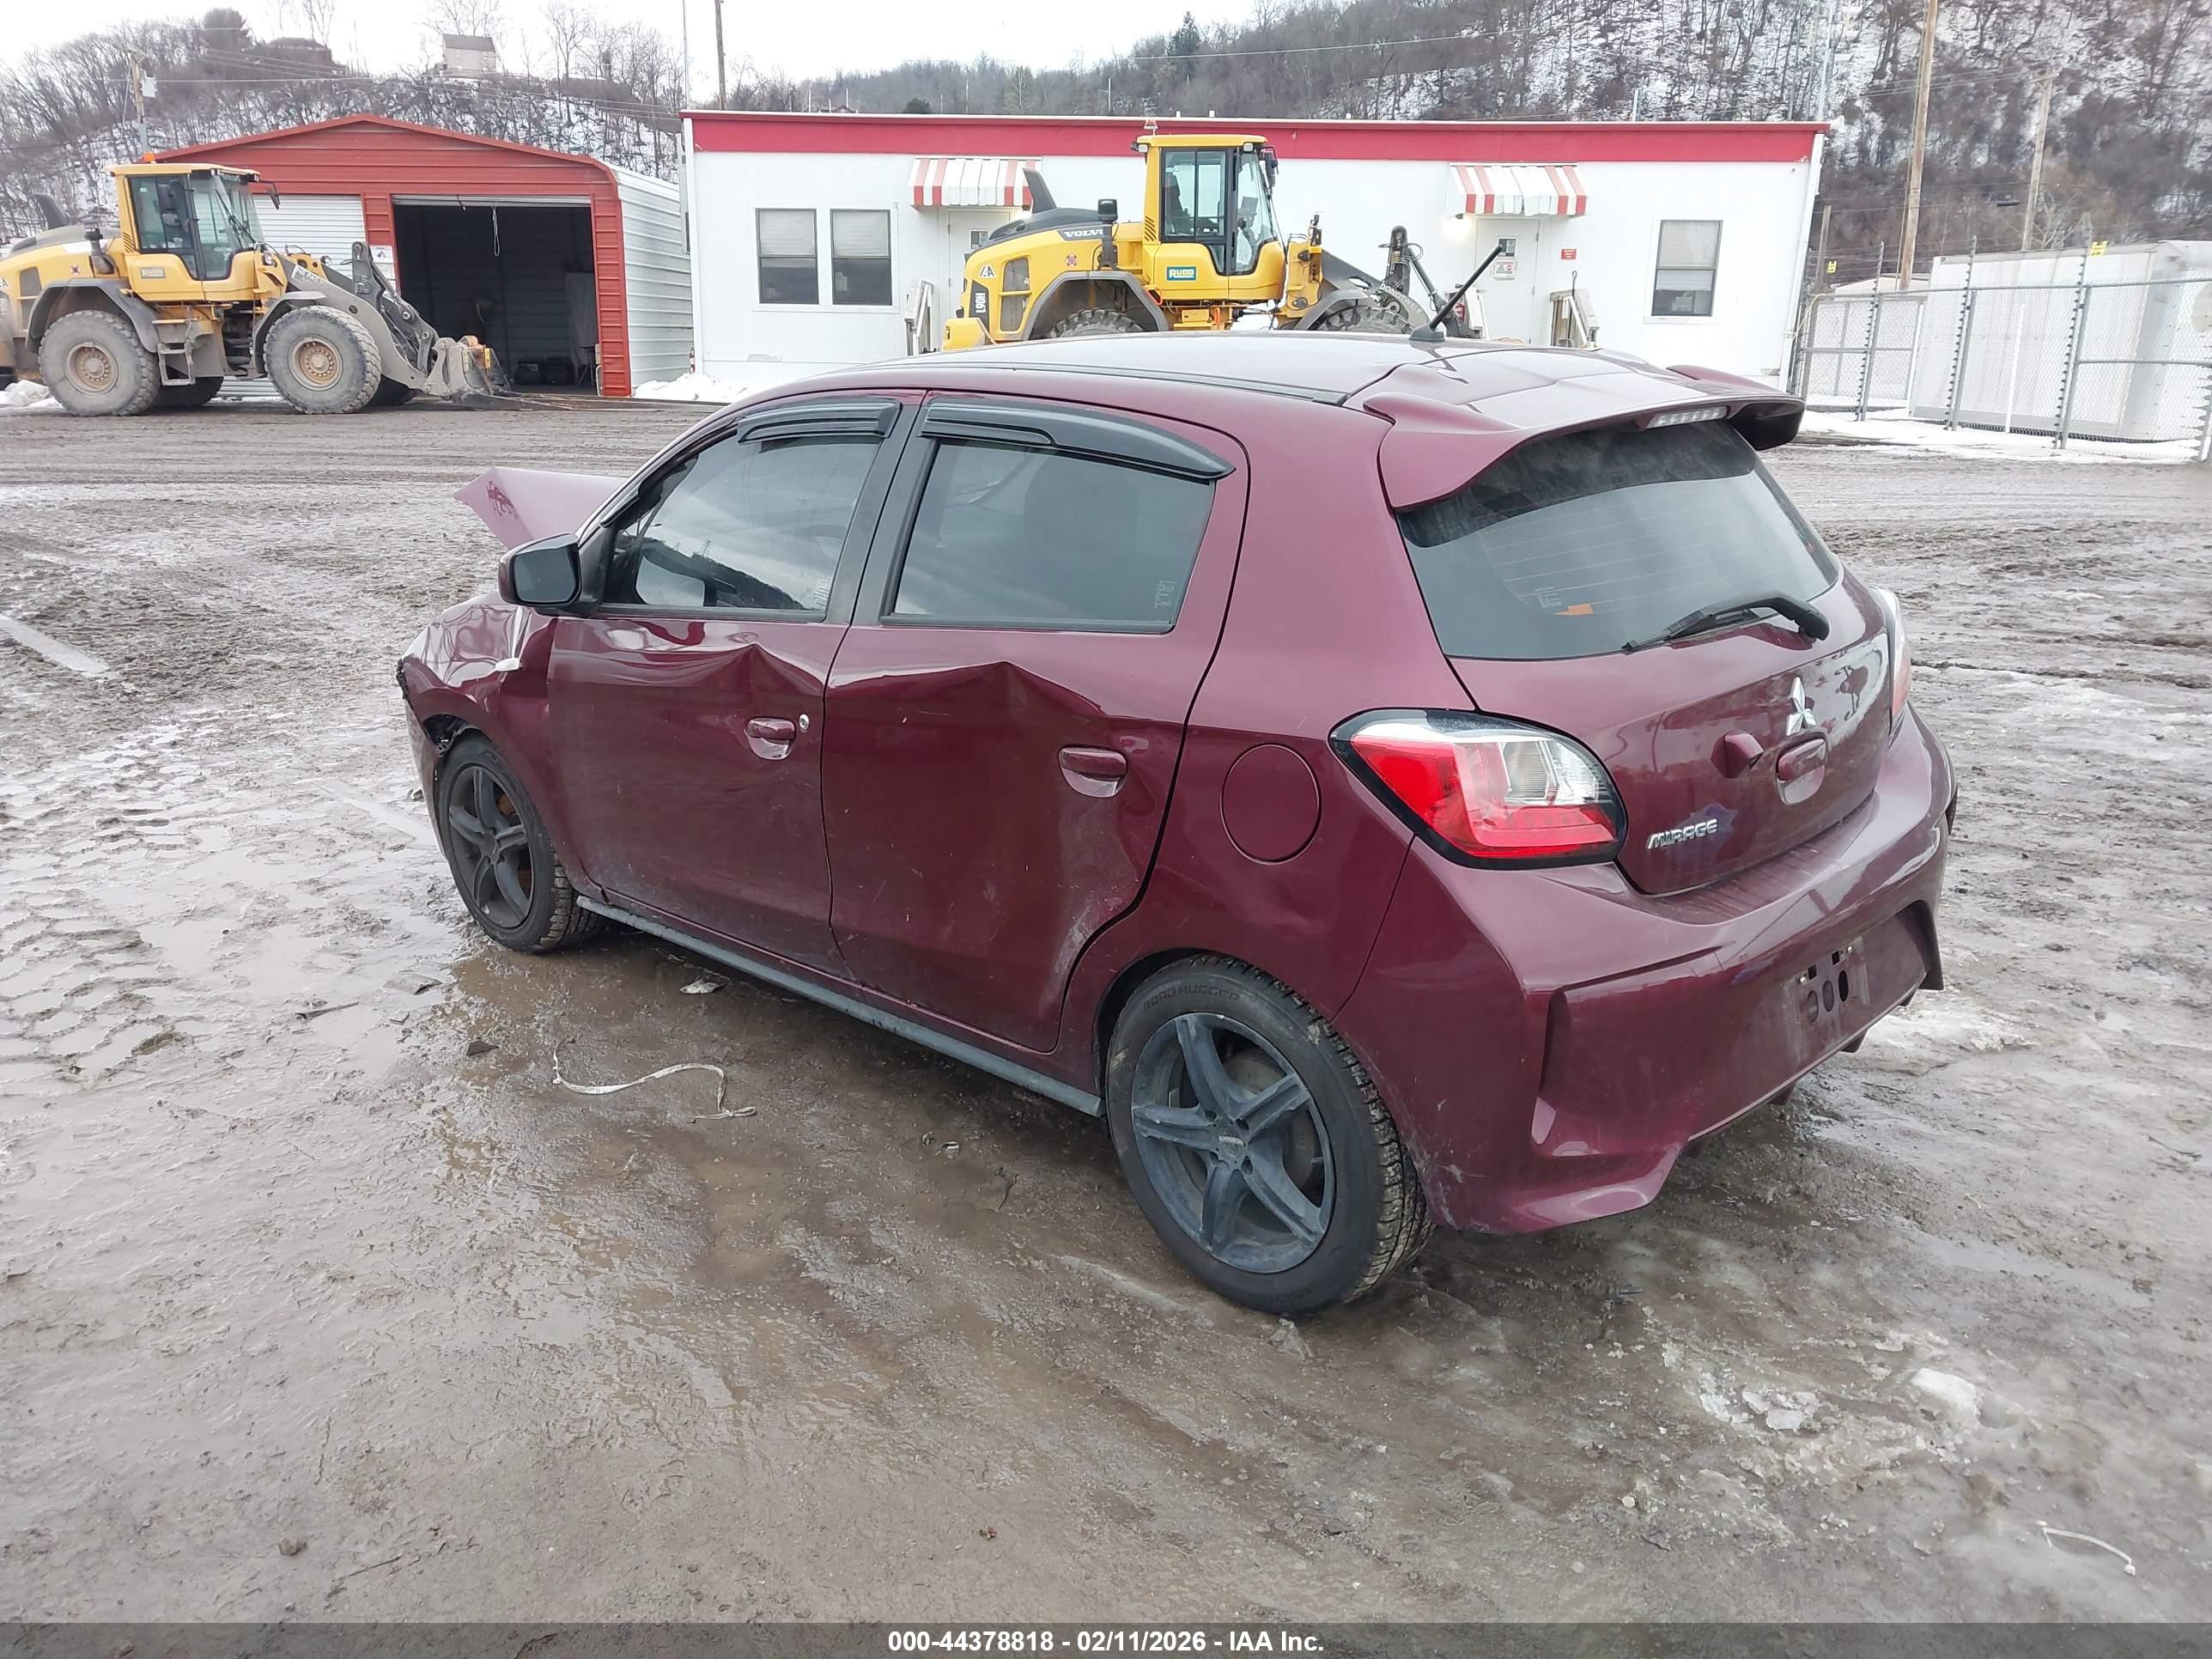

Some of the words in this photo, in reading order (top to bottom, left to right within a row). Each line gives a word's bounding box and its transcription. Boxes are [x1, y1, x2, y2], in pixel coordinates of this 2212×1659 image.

[1646, 818, 1718, 849] MIRAGE
[1143, 988, 1176, 1012] ROAD
[1178, 984, 1241, 1001] HUGGER
